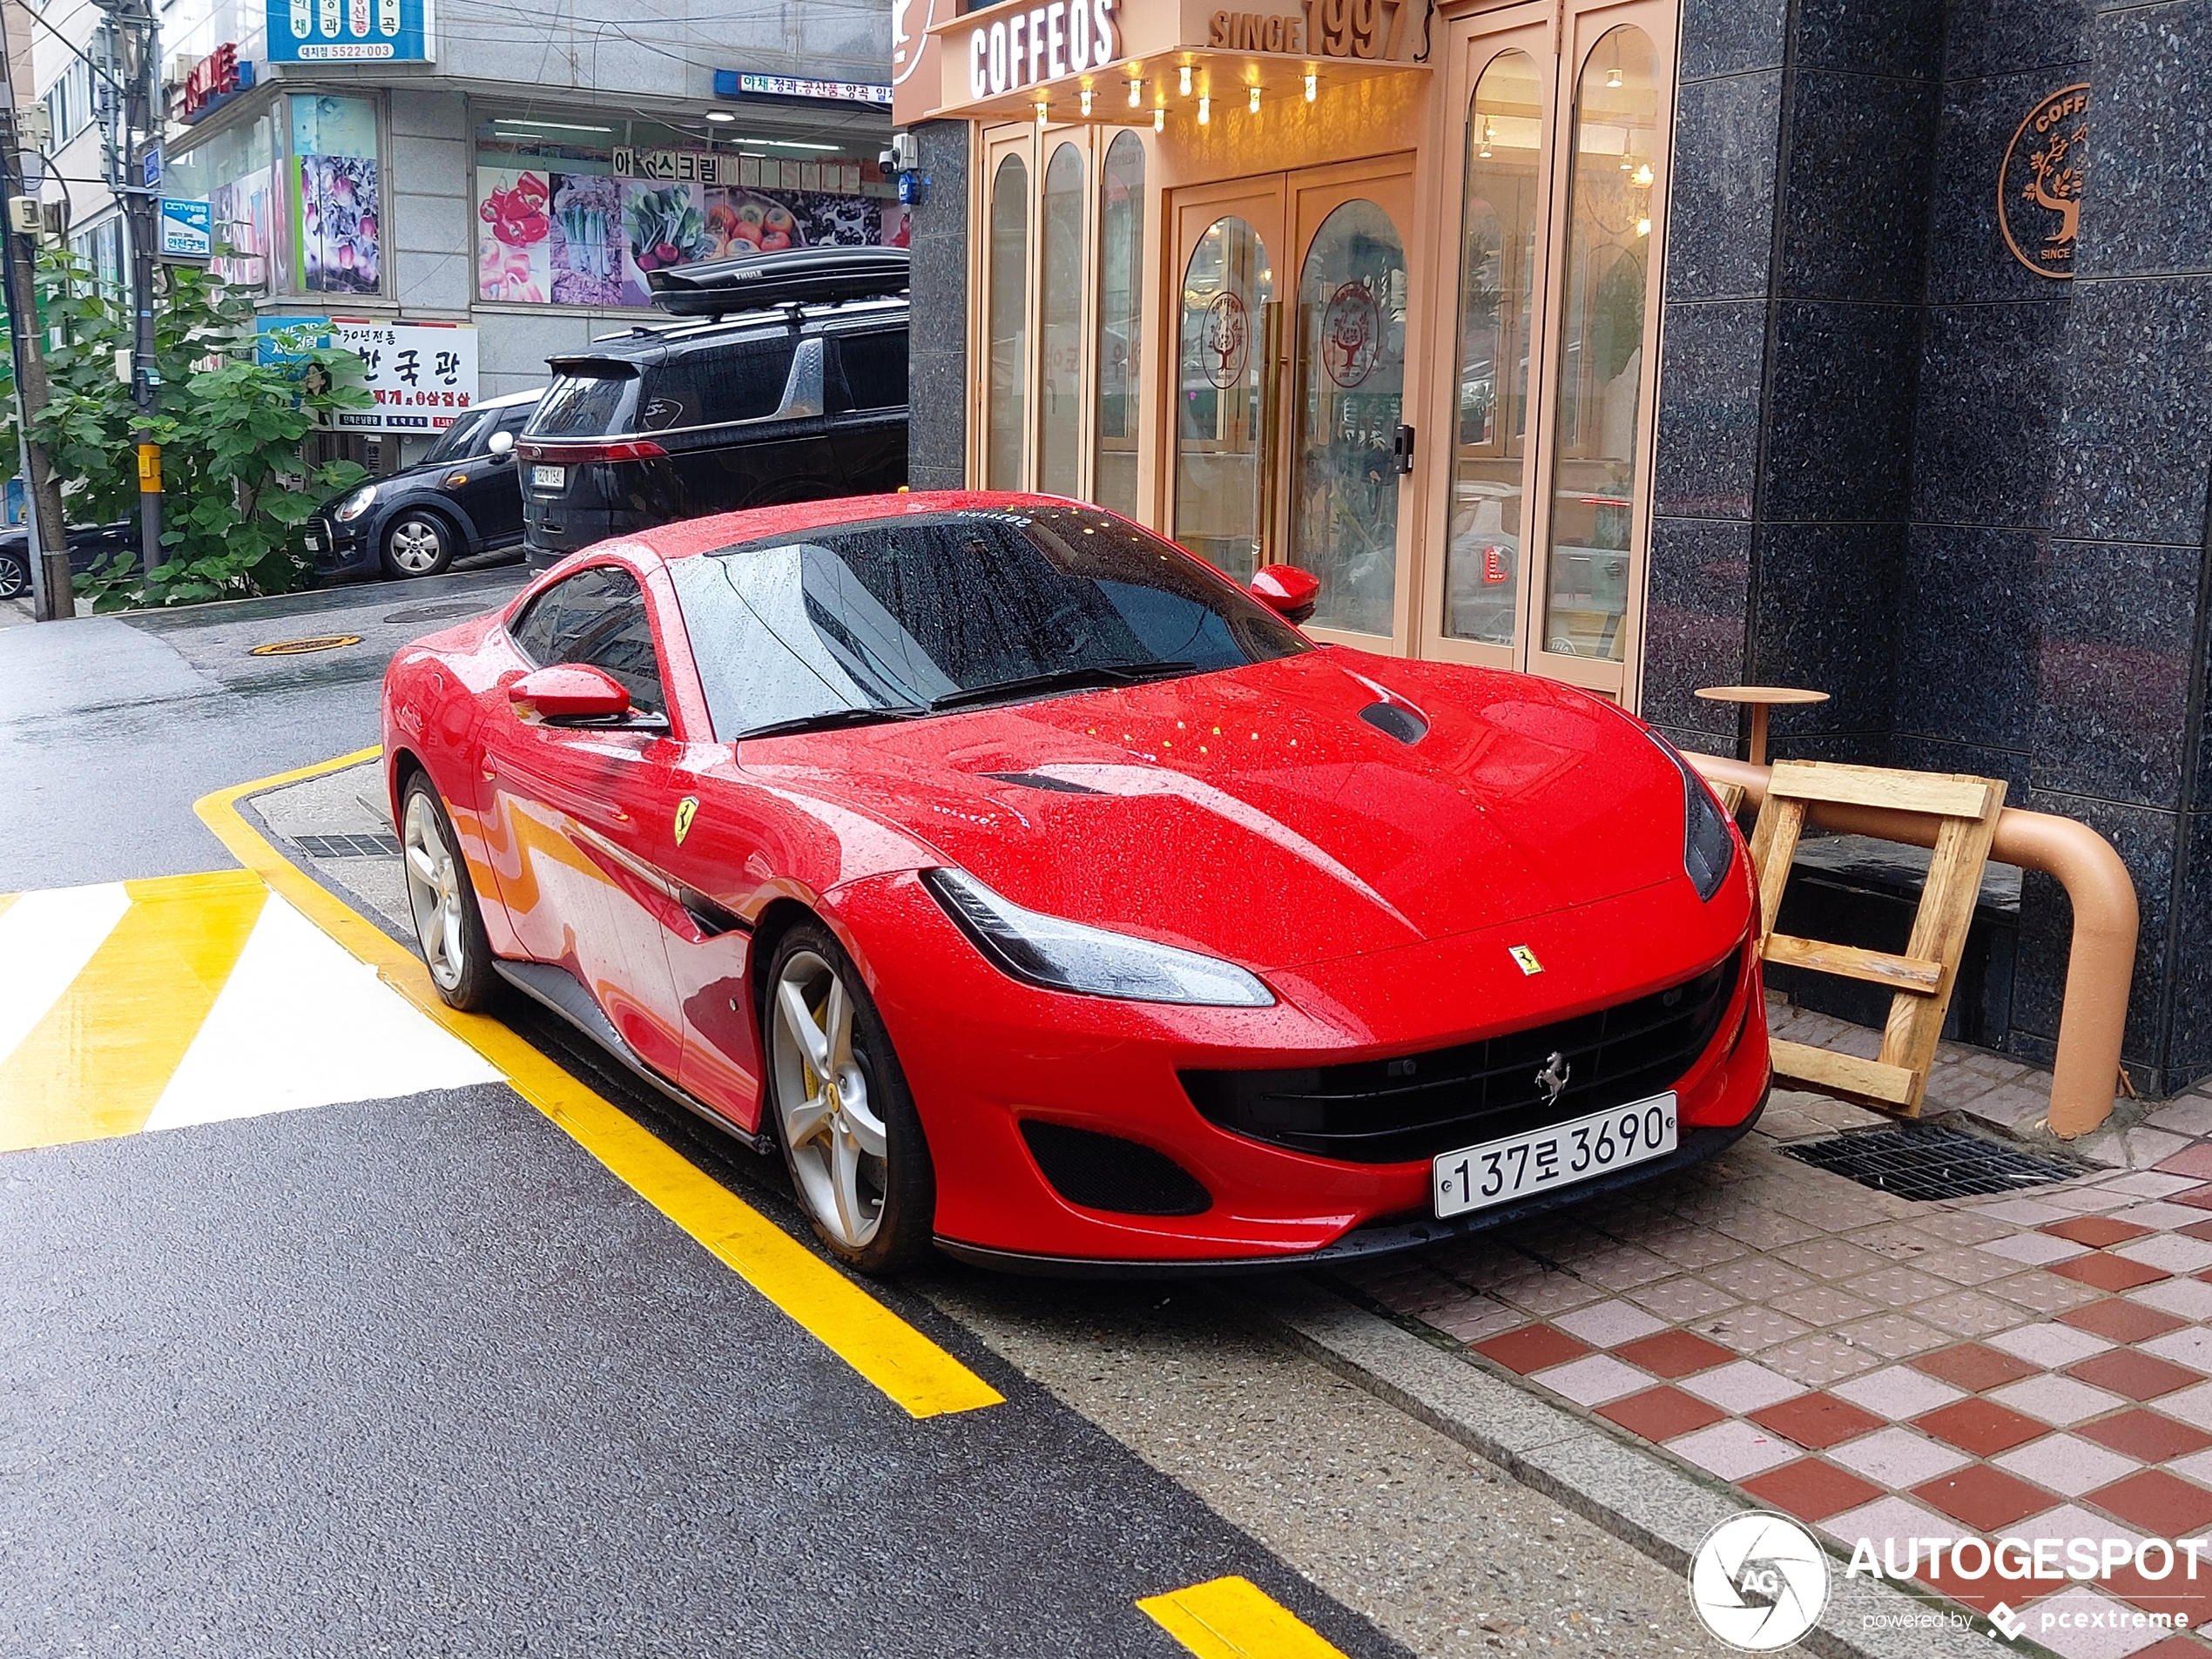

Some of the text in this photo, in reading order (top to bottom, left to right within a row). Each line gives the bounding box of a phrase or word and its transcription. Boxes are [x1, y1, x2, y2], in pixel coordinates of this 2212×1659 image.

[1210, 0, 1409, 61] SINCE 1997
[332, 46, 389, 57] 5522-003
[969, 0, 1113, 100] COFFEOS
[2035, 96, 2089, 132] COFF
[167, 237, 206, 250] 안전구역
[2040, 247, 2071, 260] SINCE
